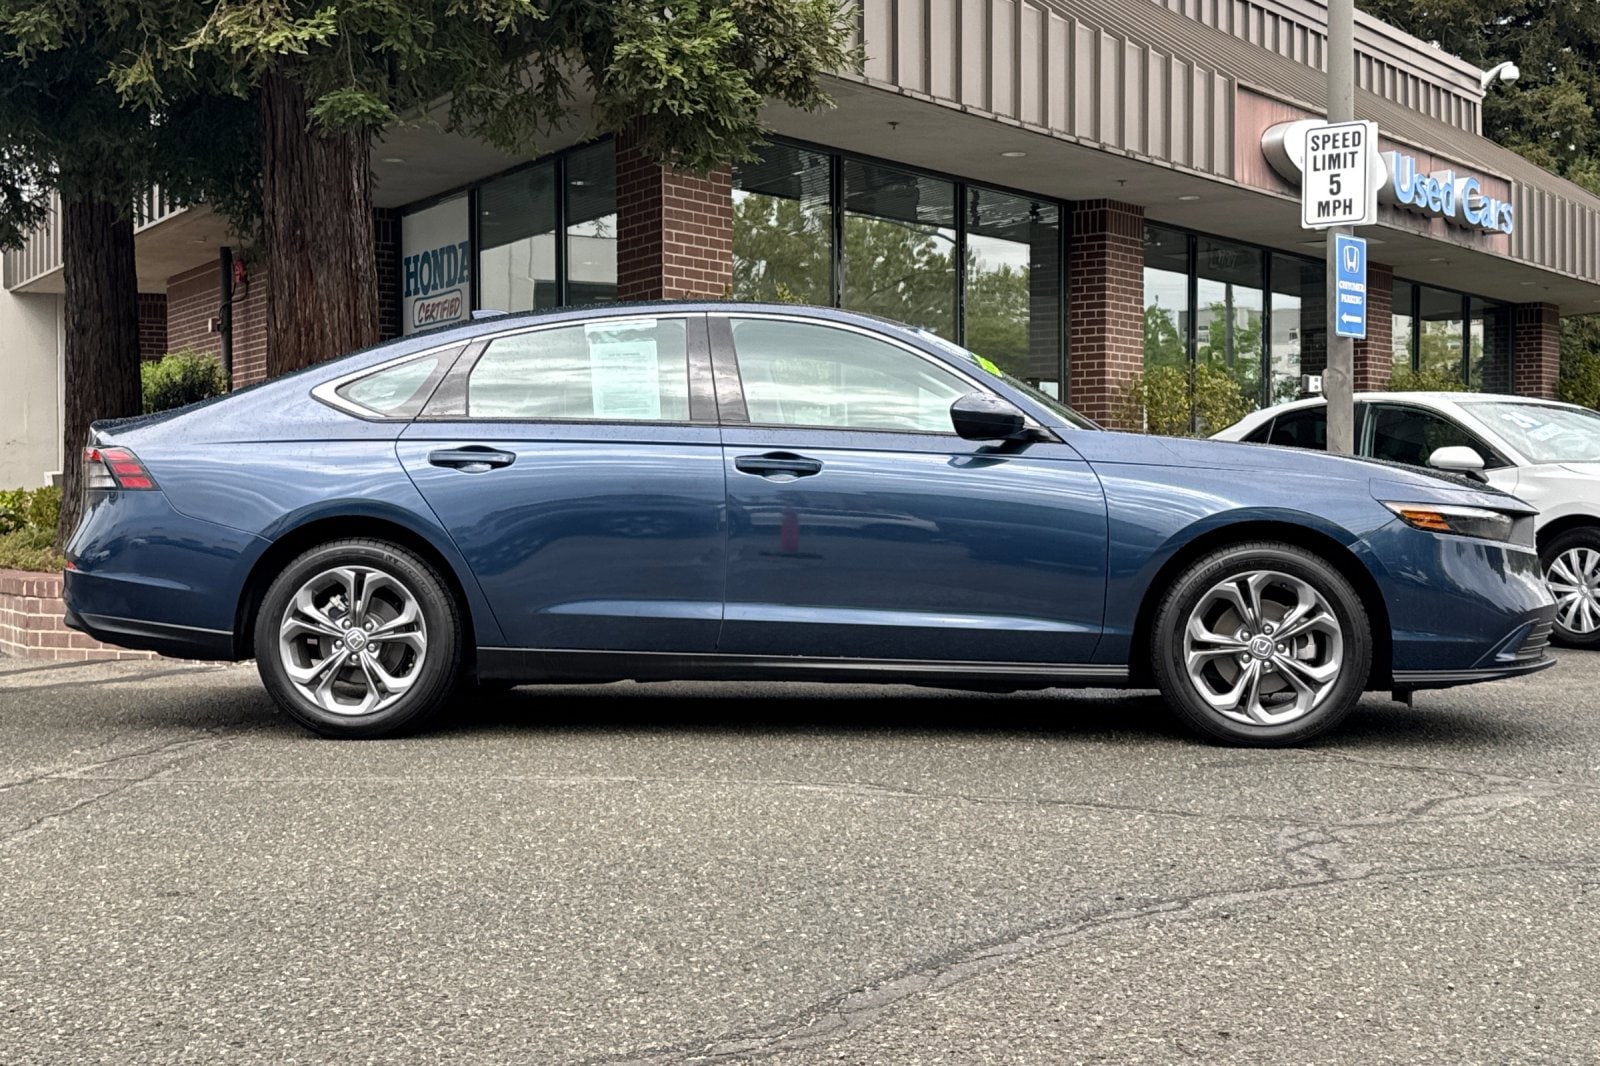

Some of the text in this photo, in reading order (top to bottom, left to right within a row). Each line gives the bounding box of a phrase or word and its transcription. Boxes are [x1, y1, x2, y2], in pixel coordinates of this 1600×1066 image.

[1311, 131, 1361, 151] SPEED
[1313, 151, 1358, 172] LIMIT
[1329, 173, 1341, 196] 5
[1393, 150, 1514, 235] Used Cars
[1317, 198, 1353, 218] MPH
[404, 241, 469, 298] HONDA
[418, 297, 461, 323] CERTIFIED
